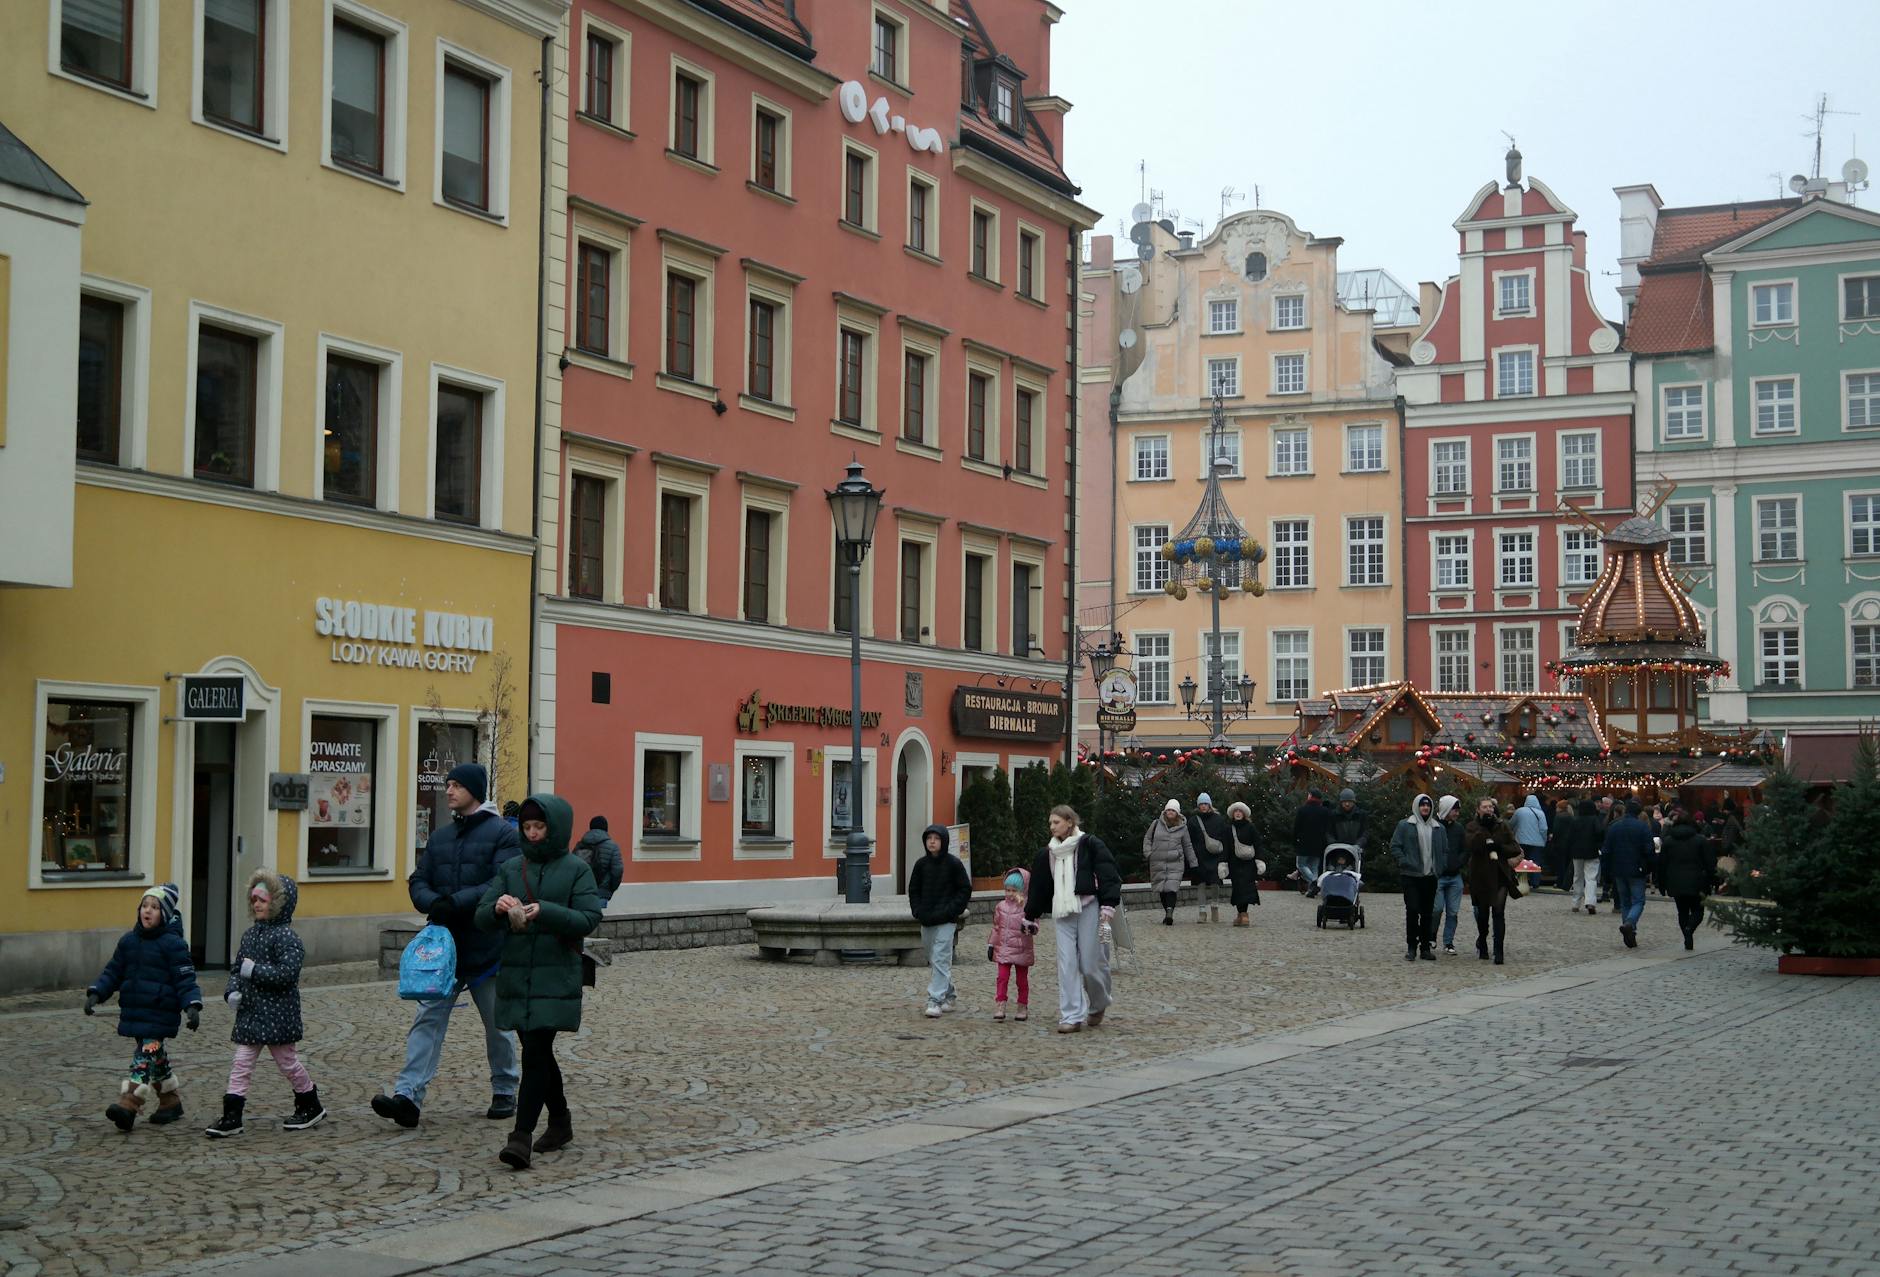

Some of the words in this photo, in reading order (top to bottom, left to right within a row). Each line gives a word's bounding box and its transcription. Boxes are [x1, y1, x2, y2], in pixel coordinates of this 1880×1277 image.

[315, 597, 417, 644] SŁODKIE
[423, 609, 494, 653] KUBKI
[331, 640, 376, 664] LODY
[377, 645, 423, 669] KAWA
[424, 651, 477, 673] GOFRY
[188, 687, 239, 709] GALERIA
[965, 694, 1021, 713] RESTAURACJA
[1027, 701, 1059, 716] BROWAR
[990, 715, 1036, 733] BIERHALLE
[311, 742, 361, 756] OTWARTE
[880, 732, 890, 748] 24
[44, 742, 127, 782] Galeria
[310, 760, 366, 773] APRASZAMY
[272, 777, 308, 799] odra
